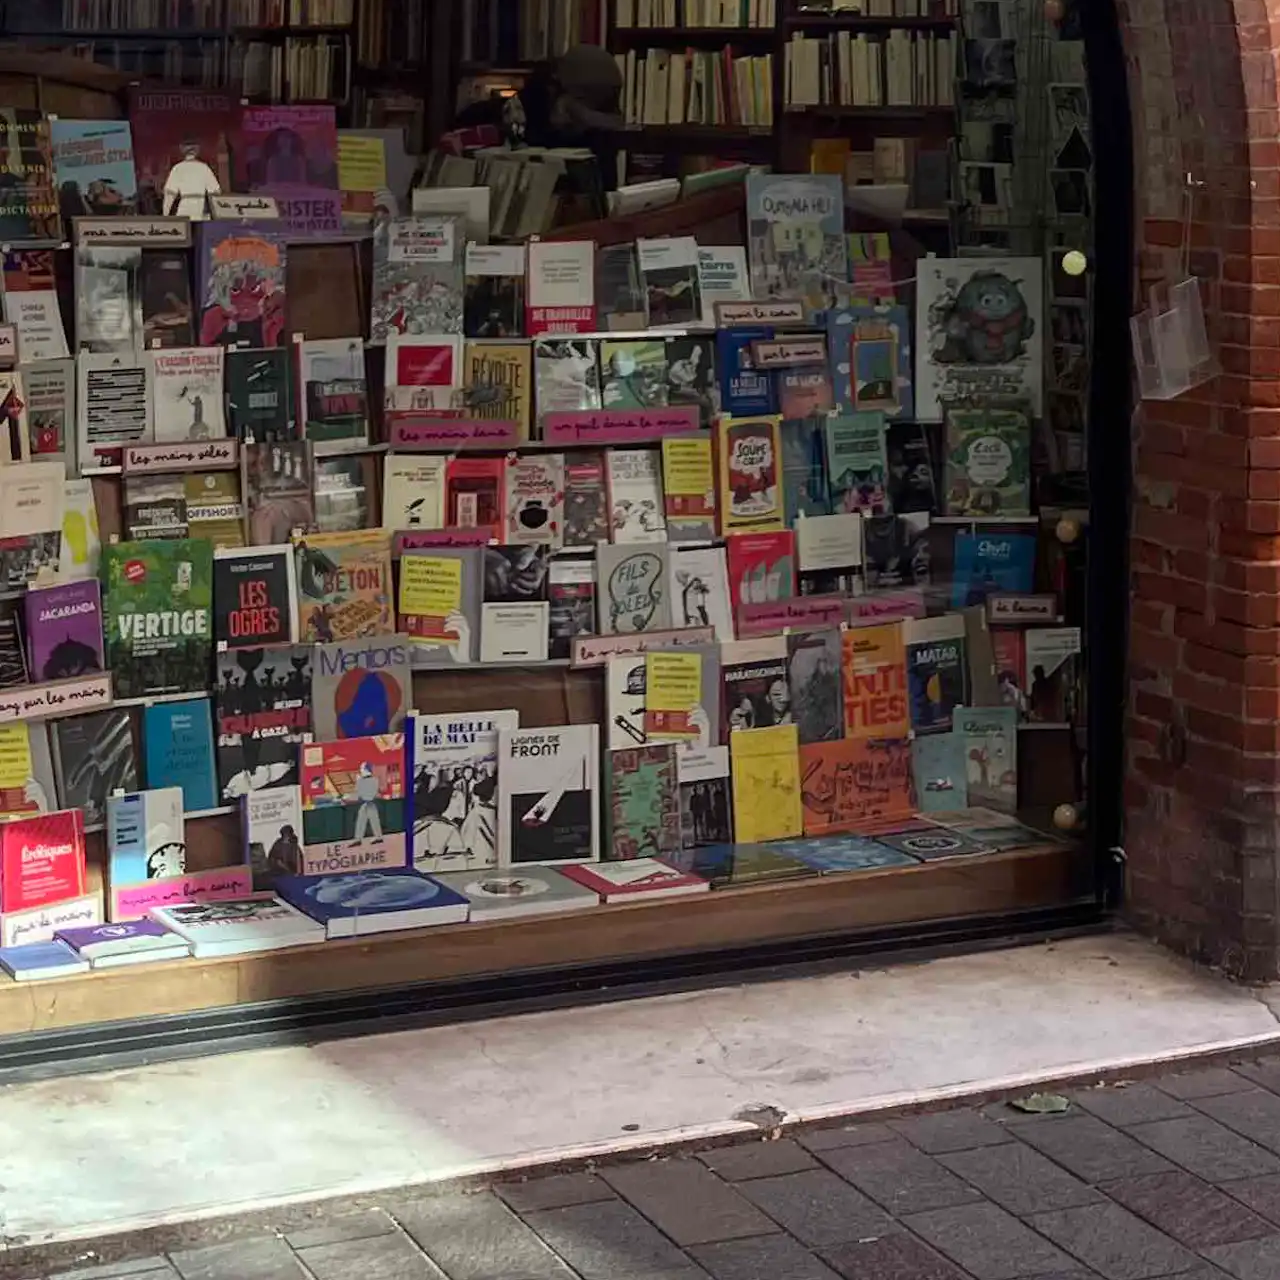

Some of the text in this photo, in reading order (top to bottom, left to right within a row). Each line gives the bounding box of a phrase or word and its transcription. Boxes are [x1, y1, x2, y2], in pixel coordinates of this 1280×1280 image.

[187, 504, 240, 519] OFFSHORE
[239, 580, 267, 609] LES
[118, 610, 207, 640] VERTIGE
[229, 607, 280, 638] OGRES
[320, 644, 405, 677] Mentors
[423, 723, 444, 736] LA
[423, 733, 444, 746] DE
[511, 743, 561, 758] FRONT
[308, 849, 388, 874] TYPOGRAPHE
[326, 845, 343, 858] LE
